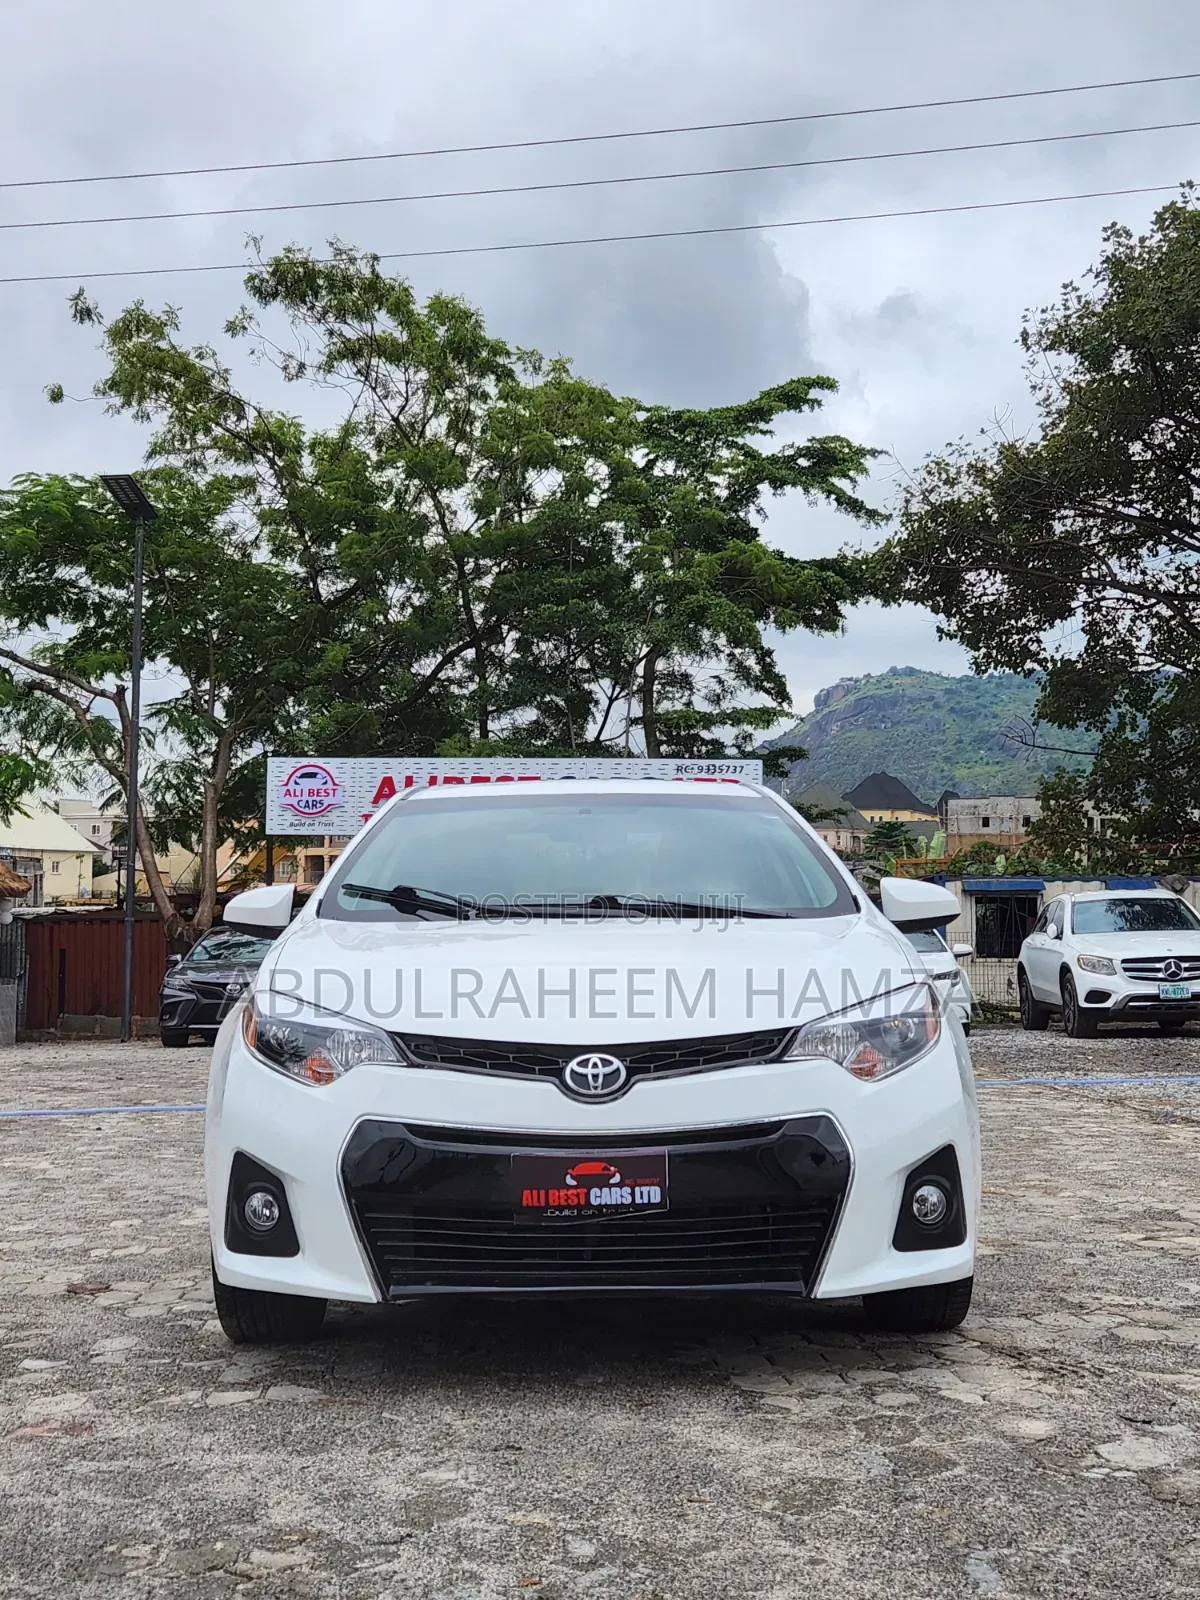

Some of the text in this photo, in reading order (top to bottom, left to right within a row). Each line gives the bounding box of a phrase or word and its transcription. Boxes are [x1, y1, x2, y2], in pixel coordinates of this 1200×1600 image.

[283, 788, 338, 798] ALI BEST
[297, 799, 324, 810] CARS
[522, 1186, 661, 1206] ALI BEST CARS LTD
